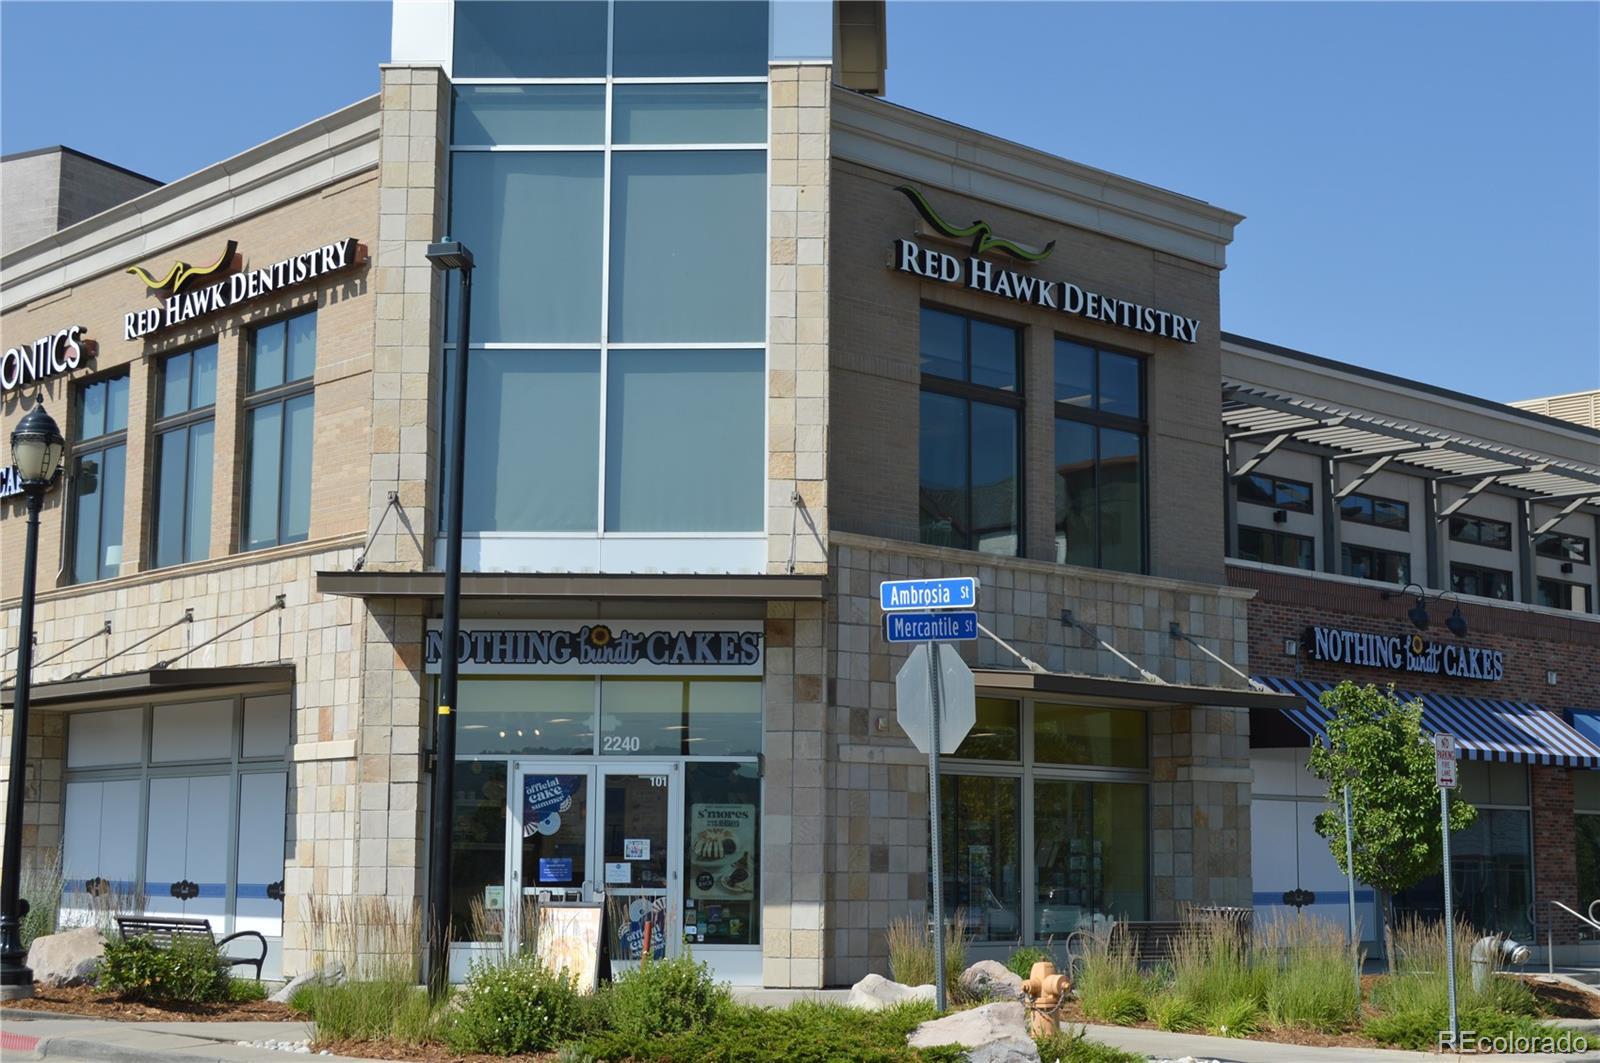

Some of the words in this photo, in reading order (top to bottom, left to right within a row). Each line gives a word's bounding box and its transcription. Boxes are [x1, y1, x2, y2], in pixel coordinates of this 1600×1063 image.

[124, 307, 161, 341] RED
[164, 282, 227, 327] HAWK
[230, 237, 350, 305] DENTISTRY
[900, 238, 960, 283] RED
[969, 256, 1057, 310] HAWK
[1063, 281, 1200, 344] DENTISTRY
[0, 325, 81, 391] ONTICS
[890, 584, 951, 605] Ambrosia
[960, 585, 970, 599] St
[894, 617, 960, 638] Mercantile
[965, 620, 974, 632] St
[576, 625, 644, 664] bundt
[646, 631, 761, 665] CAKES
[1314, 626, 1402, 669] NOTHING
[1403, 634, 1442, 674] bundt
[1443, 644, 1504, 681] CAKES
[603, 736, 640, 751] 2240
[526, 777, 560, 795] official
[649, 776, 667, 787] 101
[528, 786, 563, 804] cake
[697, 808, 749, 819] s'mores
